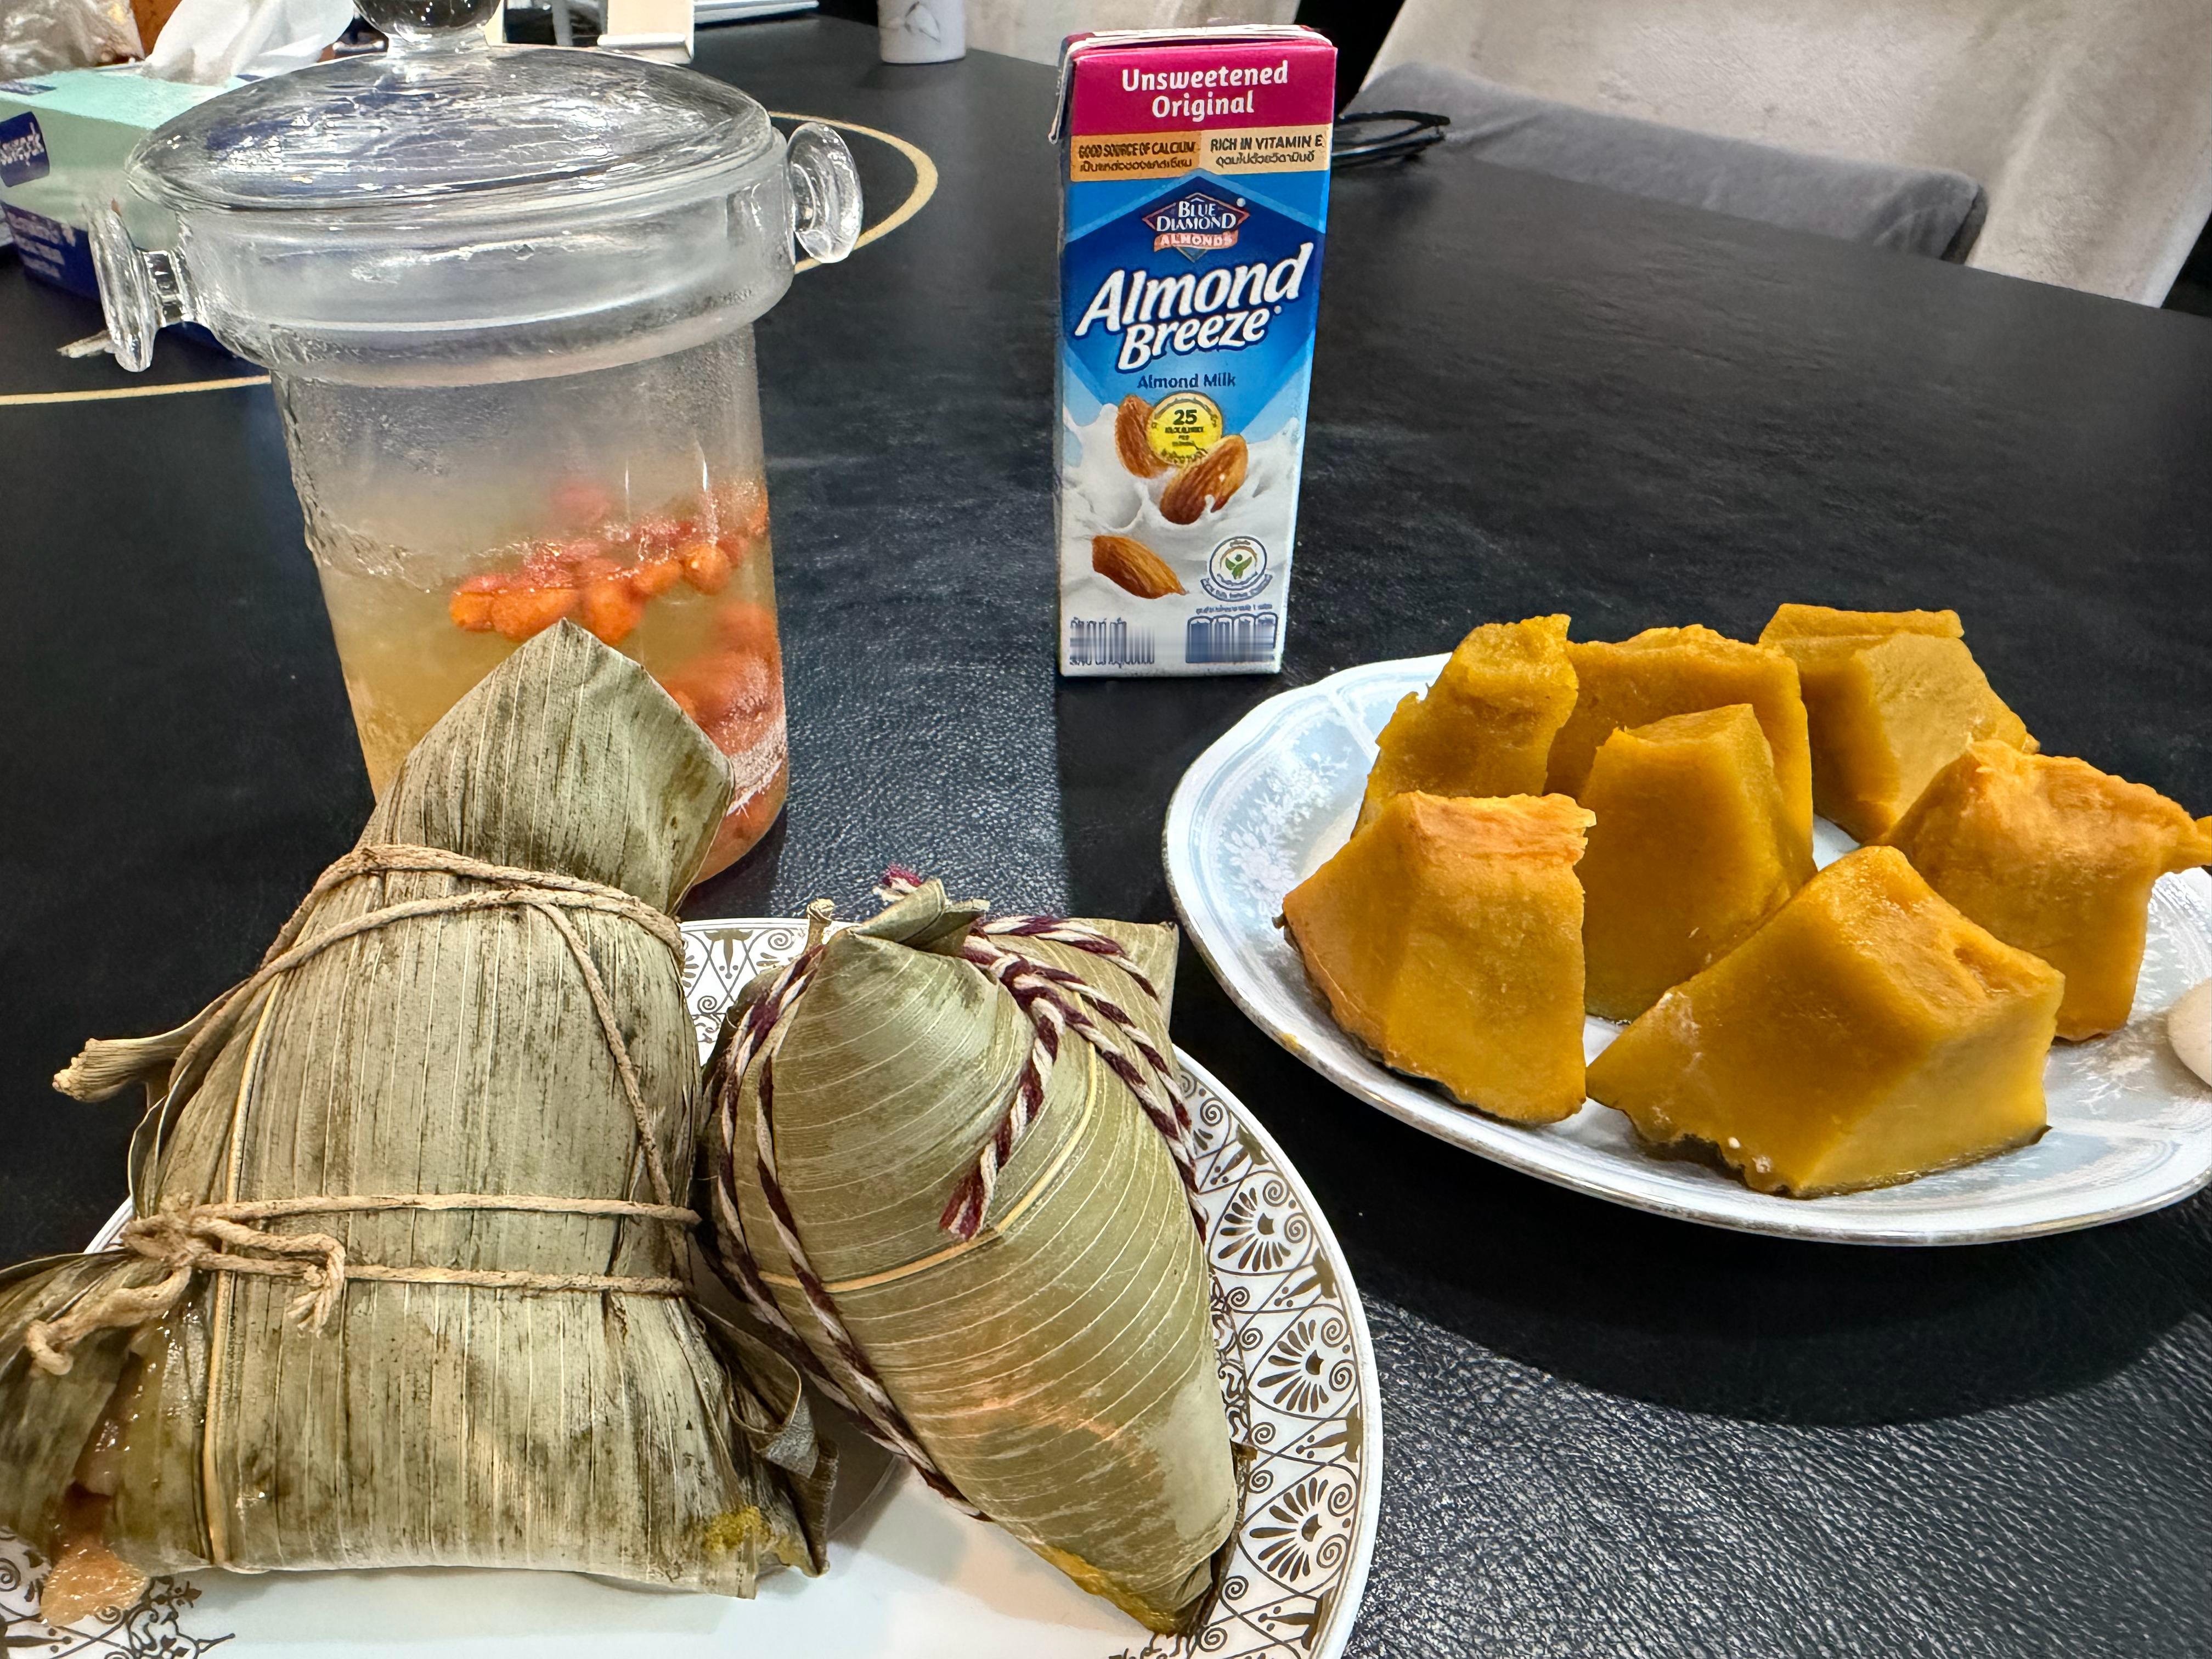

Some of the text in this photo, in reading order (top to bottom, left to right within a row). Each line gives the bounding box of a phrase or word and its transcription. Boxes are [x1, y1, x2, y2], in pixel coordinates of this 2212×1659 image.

[1122, 60, 1288, 92] Unsweetened
[1152, 90, 1255, 122] Original
[1210, 134, 1324, 152] RICH IN VITAMIN E
[1178, 200, 1216, 217] BLUE
[1156, 212, 1237, 232] DIAMOND
[1160, 232, 1233, 247] ALMONDS
[1074, 242, 1314, 337] Almond
[1117, 307, 1270, 371] Breeze
[1137, 372, 1236, 389] Almond Milk
[1172, 409, 1198, 426] 25
